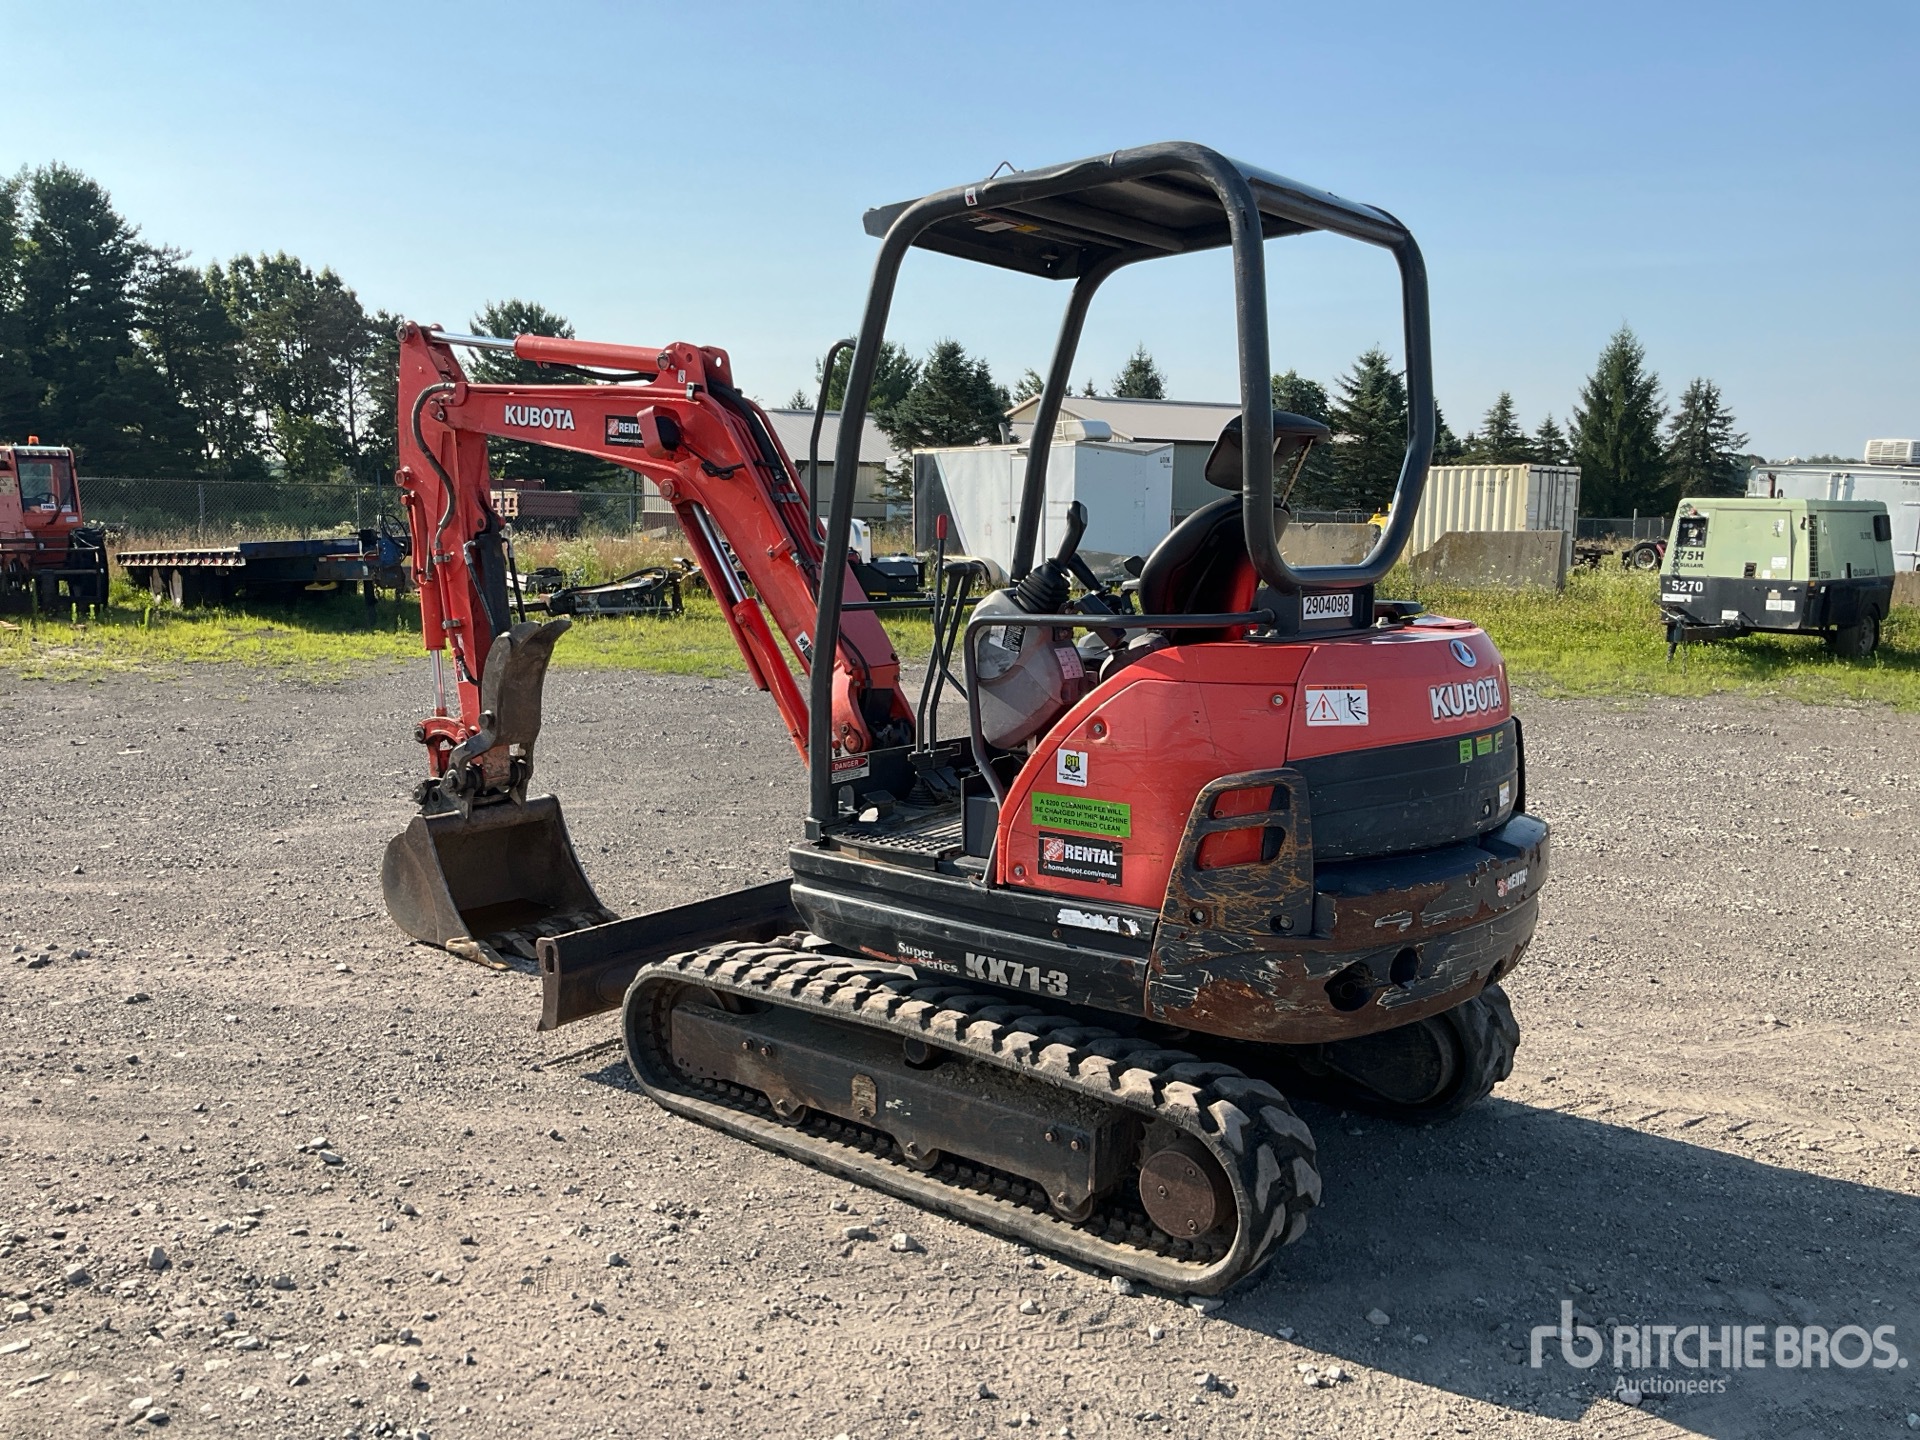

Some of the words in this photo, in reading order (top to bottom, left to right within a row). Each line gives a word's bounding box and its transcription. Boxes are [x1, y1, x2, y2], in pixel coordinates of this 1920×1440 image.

[504, 405, 575, 430] KUBOTA
[619, 422, 641, 434] RENTA
[1671, 580, 1704, 593] 5270
[1305, 595, 1350, 614] 2904098
[1430, 678, 1502, 720] KUBOTA
[834, 760, 859, 770] DANGER
[1065, 753, 1080, 768] 811
[1045, 807, 1075, 817] CHARGED
[1100, 814, 1128, 824] MACHINE
[1061, 801, 1094, 811] CLEANING
[1107, 807, 1123, 816] WILL
[1064, 818, 1098, 828] RETURNED
[1100, 823, 1121, 832] CLEAN
[1064, 844, 1117, 866] RENTAL
[1048, 863, 1117, 880] homedepot.com/rental
[897, 942, 934, 959] Super
[918, 956, 958, 974] Series
[964, 952, 1069, 997] KX71-3
